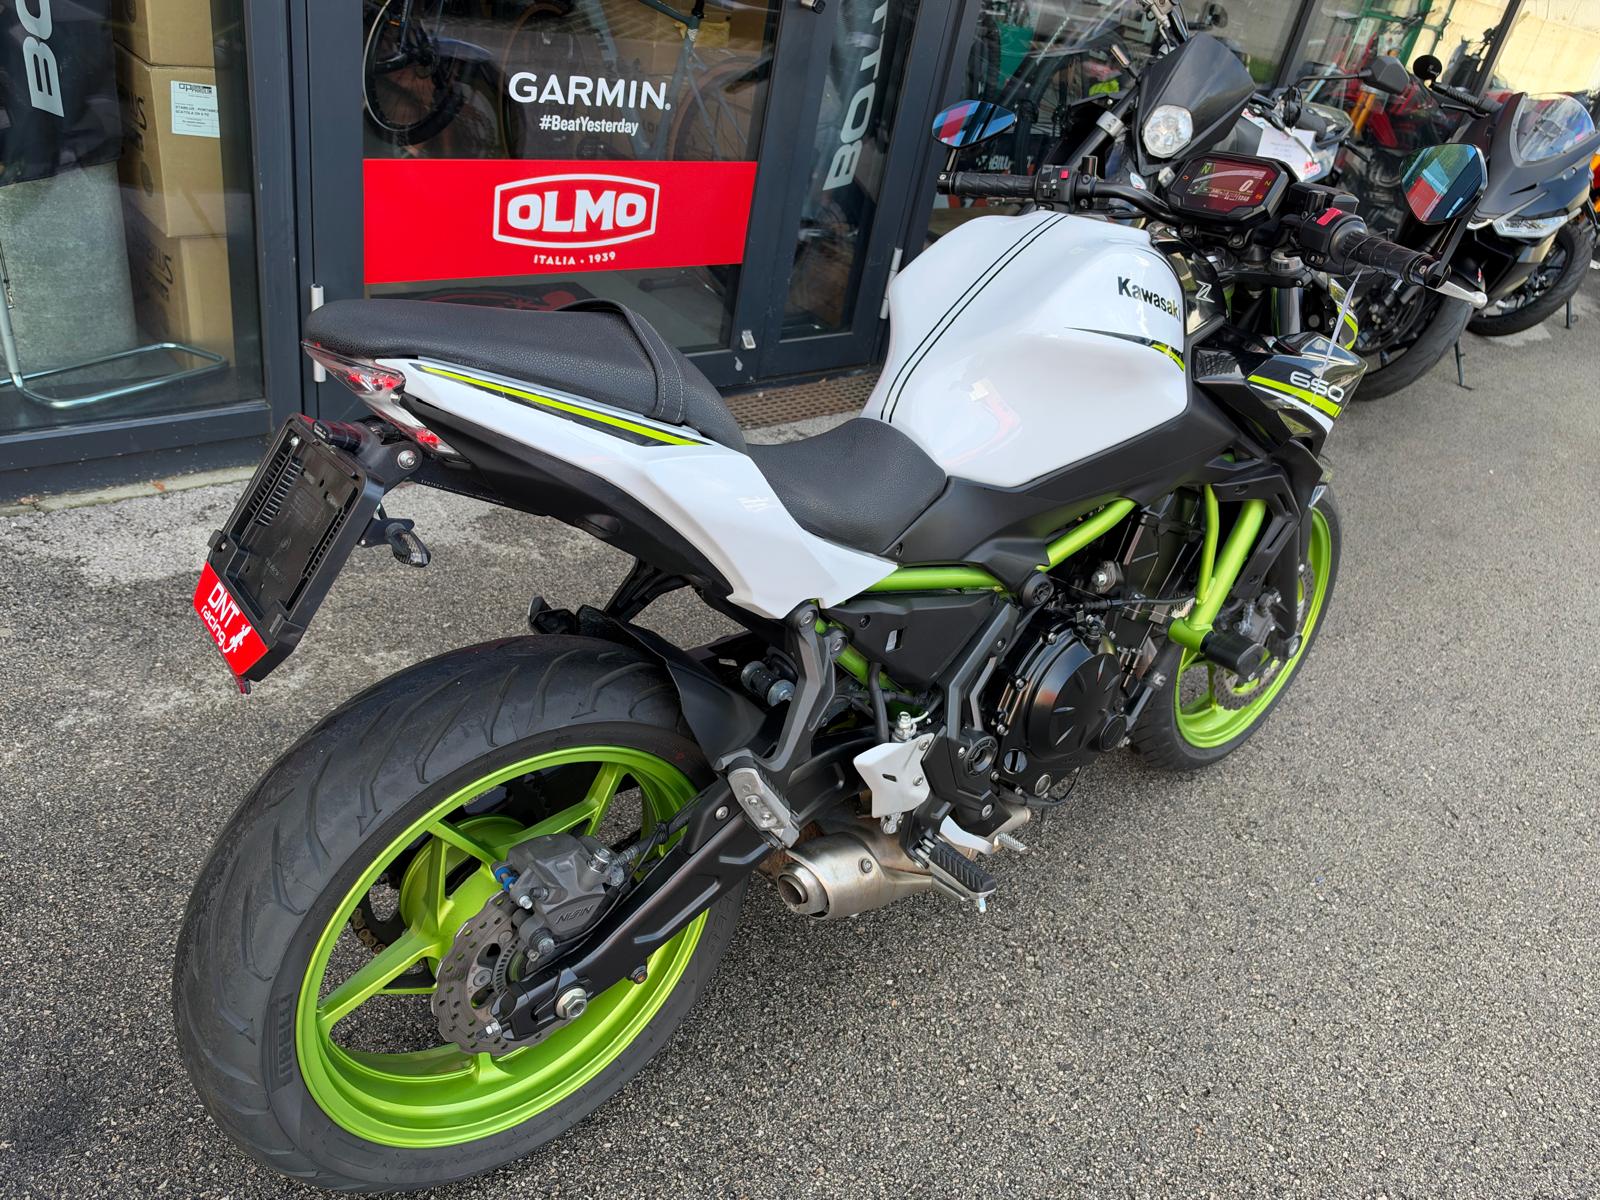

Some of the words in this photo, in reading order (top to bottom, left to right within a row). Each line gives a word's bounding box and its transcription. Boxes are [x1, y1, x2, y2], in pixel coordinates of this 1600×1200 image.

[508, 71, 667, 110] GARMIN
[538, 114, 639, 137] #BeatYesterday
[507, 189, 647, 233] OLMO
[533, 254, 576, 266] ITALIA
[588, 251, 616, 264] 1939
[1117, 276, 1181, 322] Kawasaki
[1290, 370, 1345, 403] 650
[207, 581, 240, 628] DNT
[201, 604, 226, 647] racing
